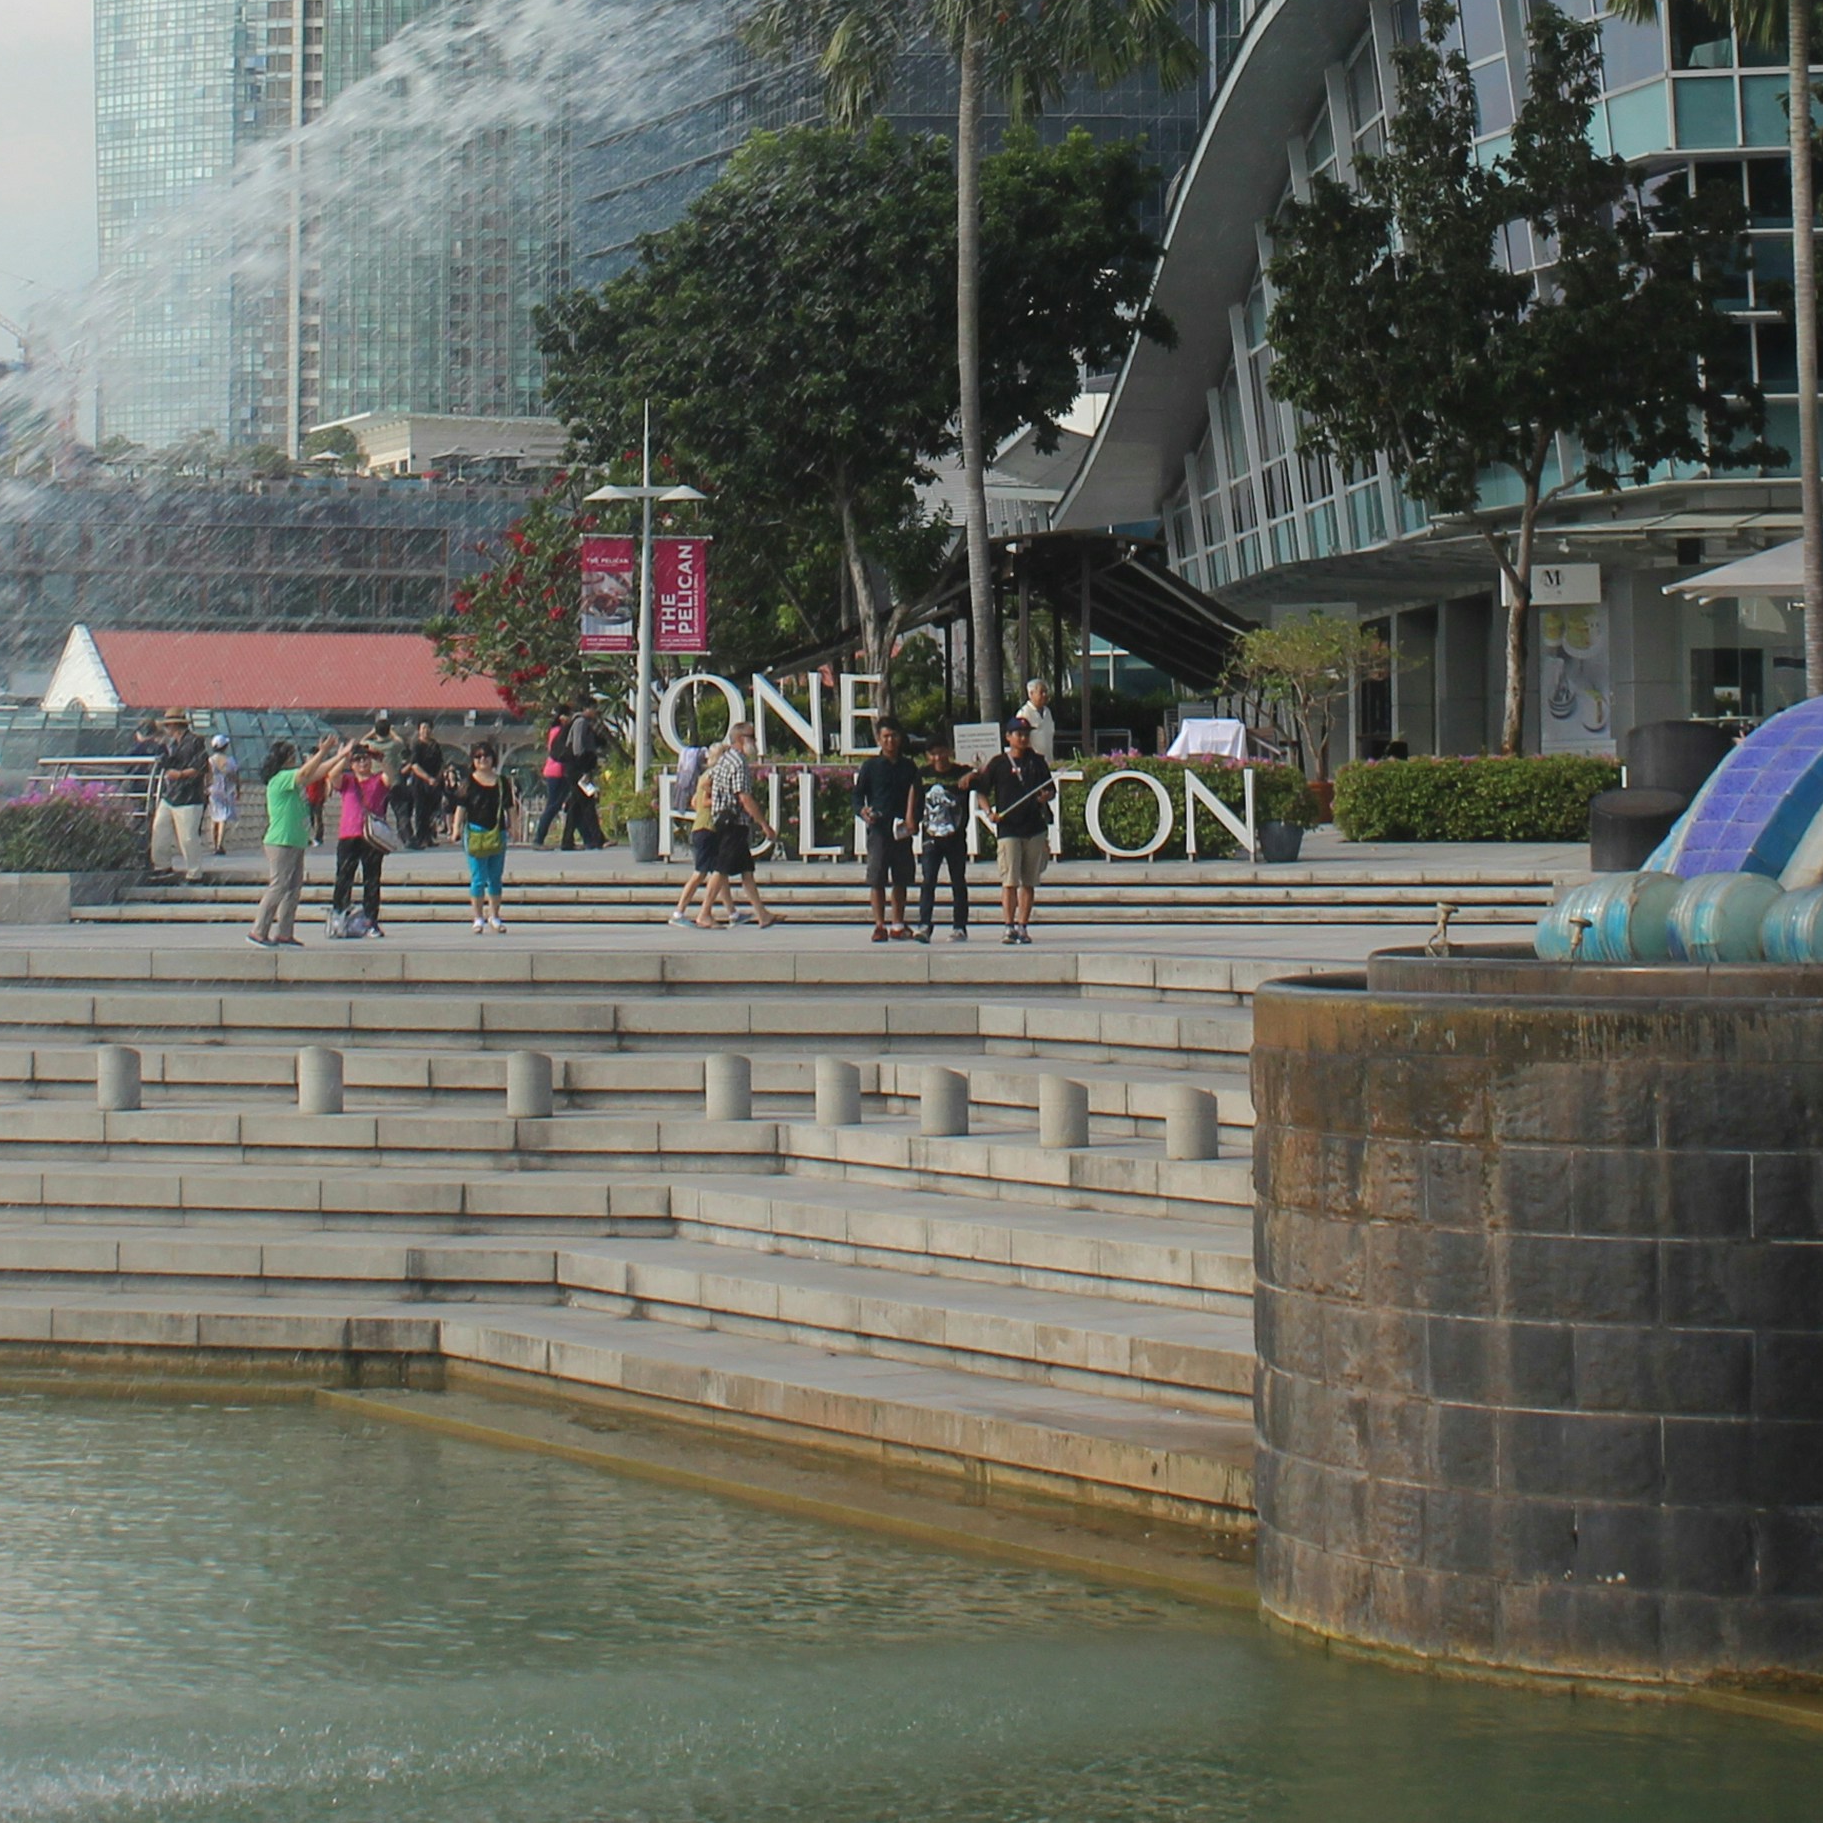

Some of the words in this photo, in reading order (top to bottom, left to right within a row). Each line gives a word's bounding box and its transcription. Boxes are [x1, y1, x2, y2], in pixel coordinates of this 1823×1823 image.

[660, 593, 677, 635] THE
[677, 544, 694, 635] PELICAN
[658, 671, 882, 756] ONE
